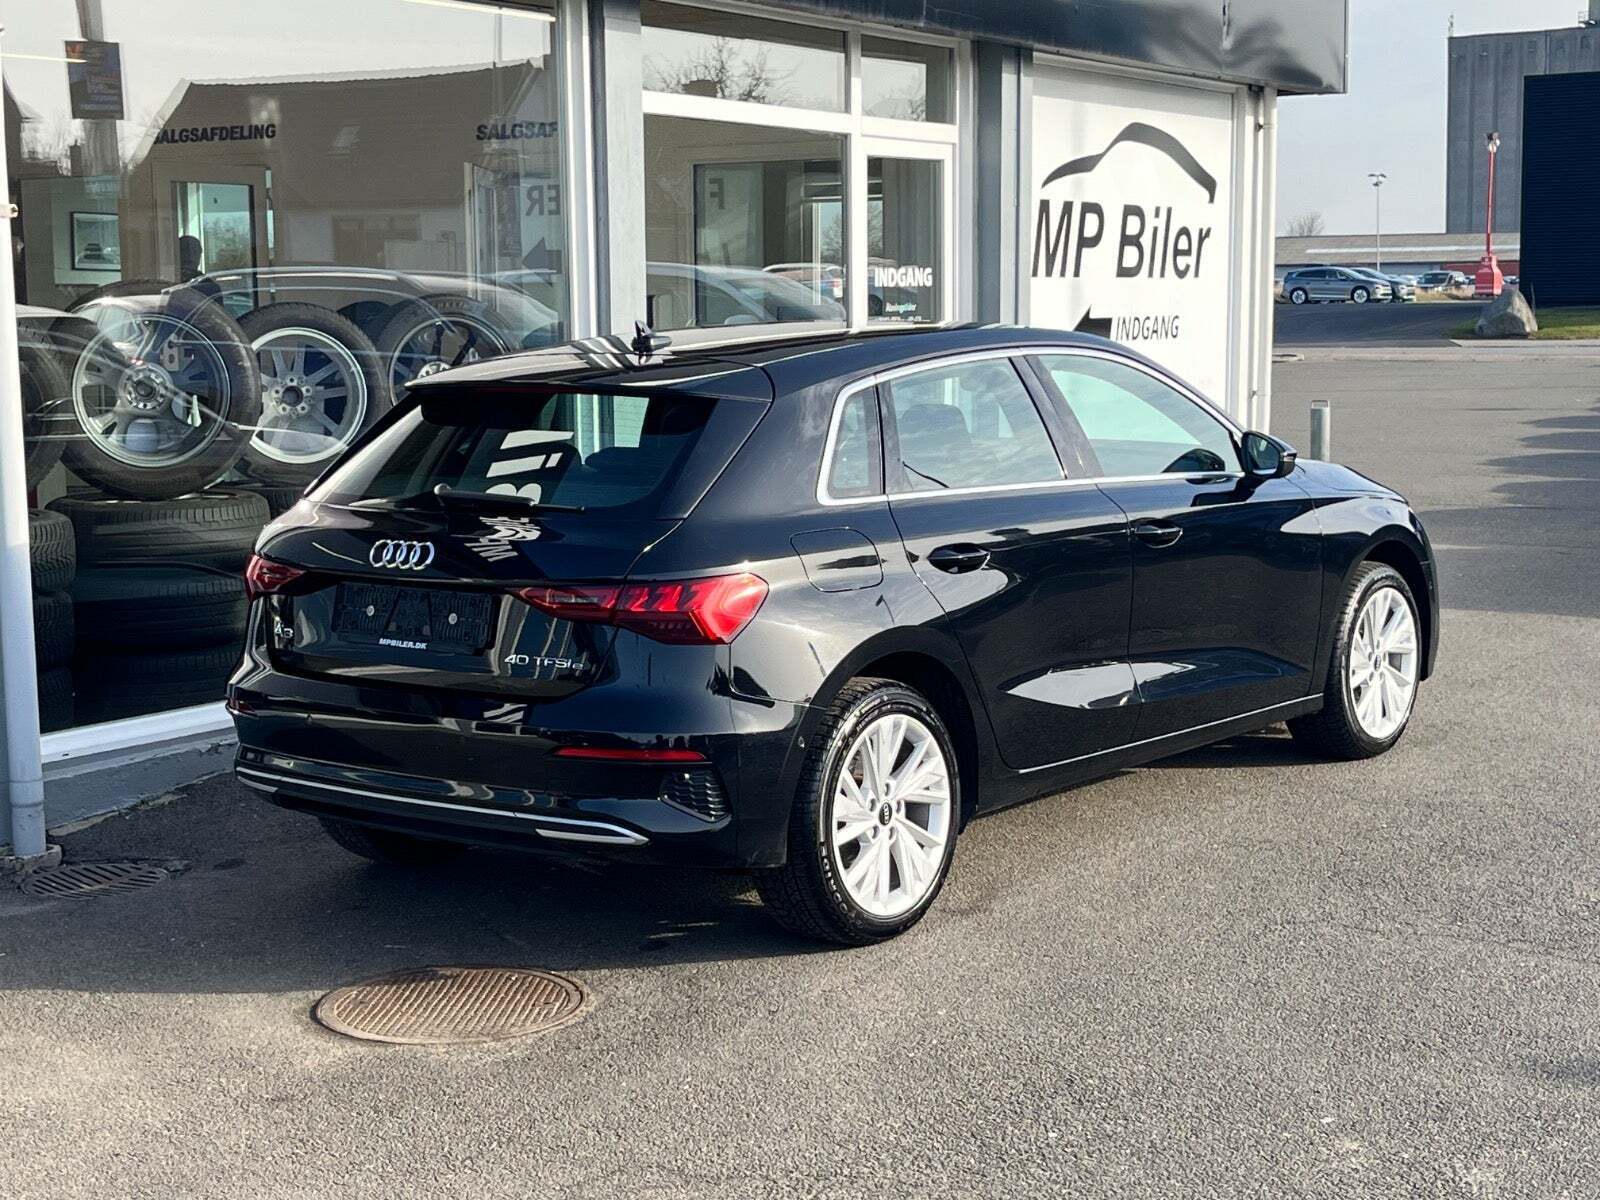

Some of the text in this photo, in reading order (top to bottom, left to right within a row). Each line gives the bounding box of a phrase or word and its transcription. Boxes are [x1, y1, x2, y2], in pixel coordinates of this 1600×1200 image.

[1031, 199, 1212, 280] MP Biler
[874, 266, 933, 288] INDGANG
[1115, 315, 1180, 341] INDGANG
[379, 638, 428, 649] MPBILER.DK
[504, 654, 530, 665] 40
